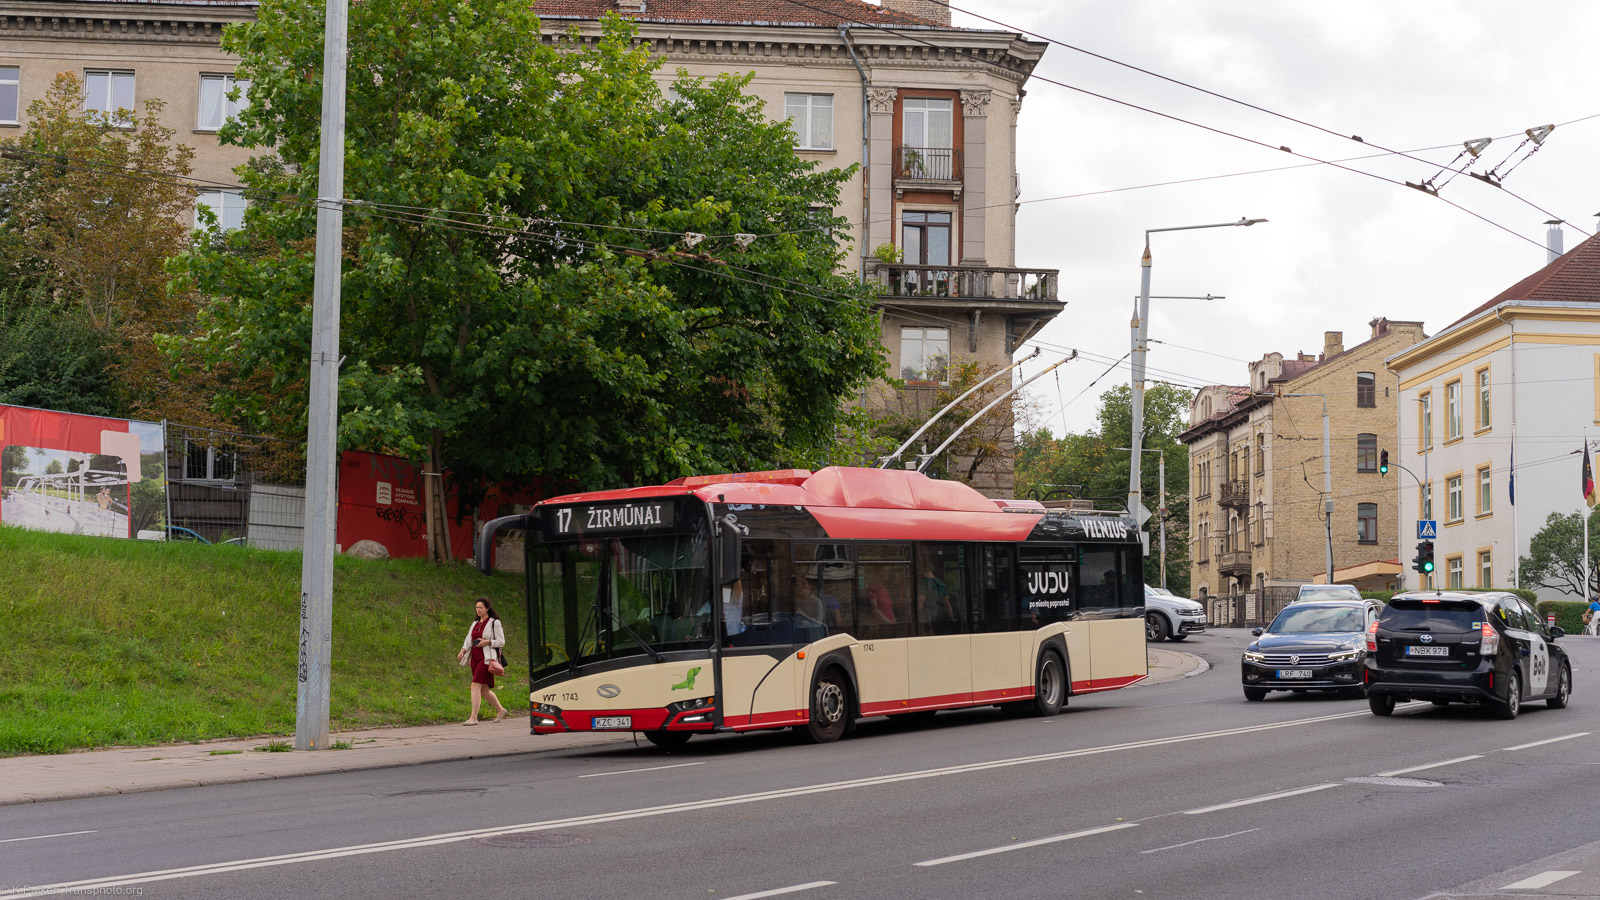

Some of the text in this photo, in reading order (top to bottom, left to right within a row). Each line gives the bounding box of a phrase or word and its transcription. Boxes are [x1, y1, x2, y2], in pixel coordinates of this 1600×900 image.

[556, 503, 662, 533] 17 ŽIRMŪNAI
[1079, 518, 1127, 539] VILNIUS
[1028, 571, 1069, 595] JUDU
[1029, 601, 1036, 610] po
[1035, 599, 1049, 609] miestą
[1414, 646, 1448, 655] NBK 978
[1533, 654, 1546, 676] Bolt
[1280, 670, 1312, 678] LRF 740
[561, 692, 579, 702] 1743
[595, 717, 630, 728] KZC 341
